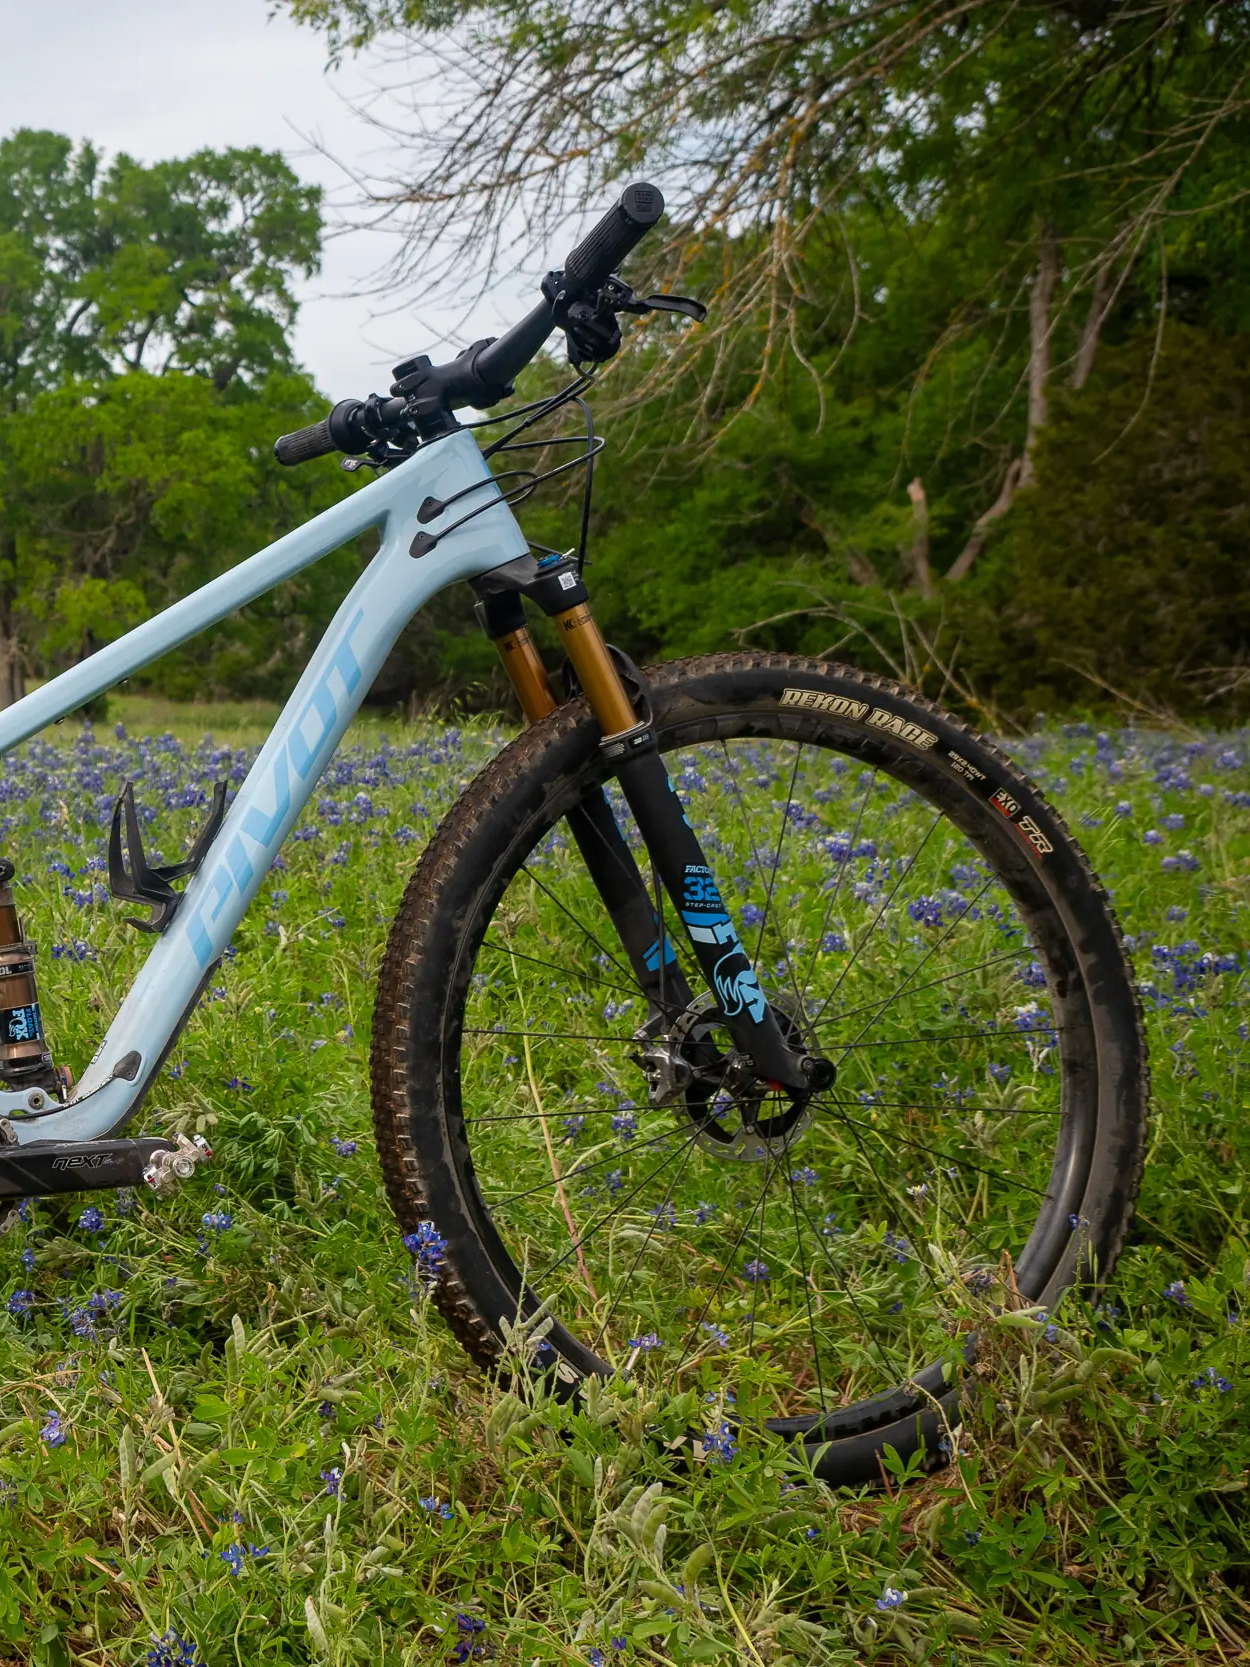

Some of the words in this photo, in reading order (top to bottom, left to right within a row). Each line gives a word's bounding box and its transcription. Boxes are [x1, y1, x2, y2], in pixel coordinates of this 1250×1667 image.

[779, 688, 870, 721] REKON
[866, 708, 938, 750] RACE
[951, 762, 964, 773] 120
[963, 770, 975, 781] TPI
[186, 608, 364, 970] PIVOT
[995, 790, 1018, 814] EXO
[1018, 815, 1053, 853] TR
[683, 876, 720, 900] 32
[9, 1008, 29, 1040] FOX
